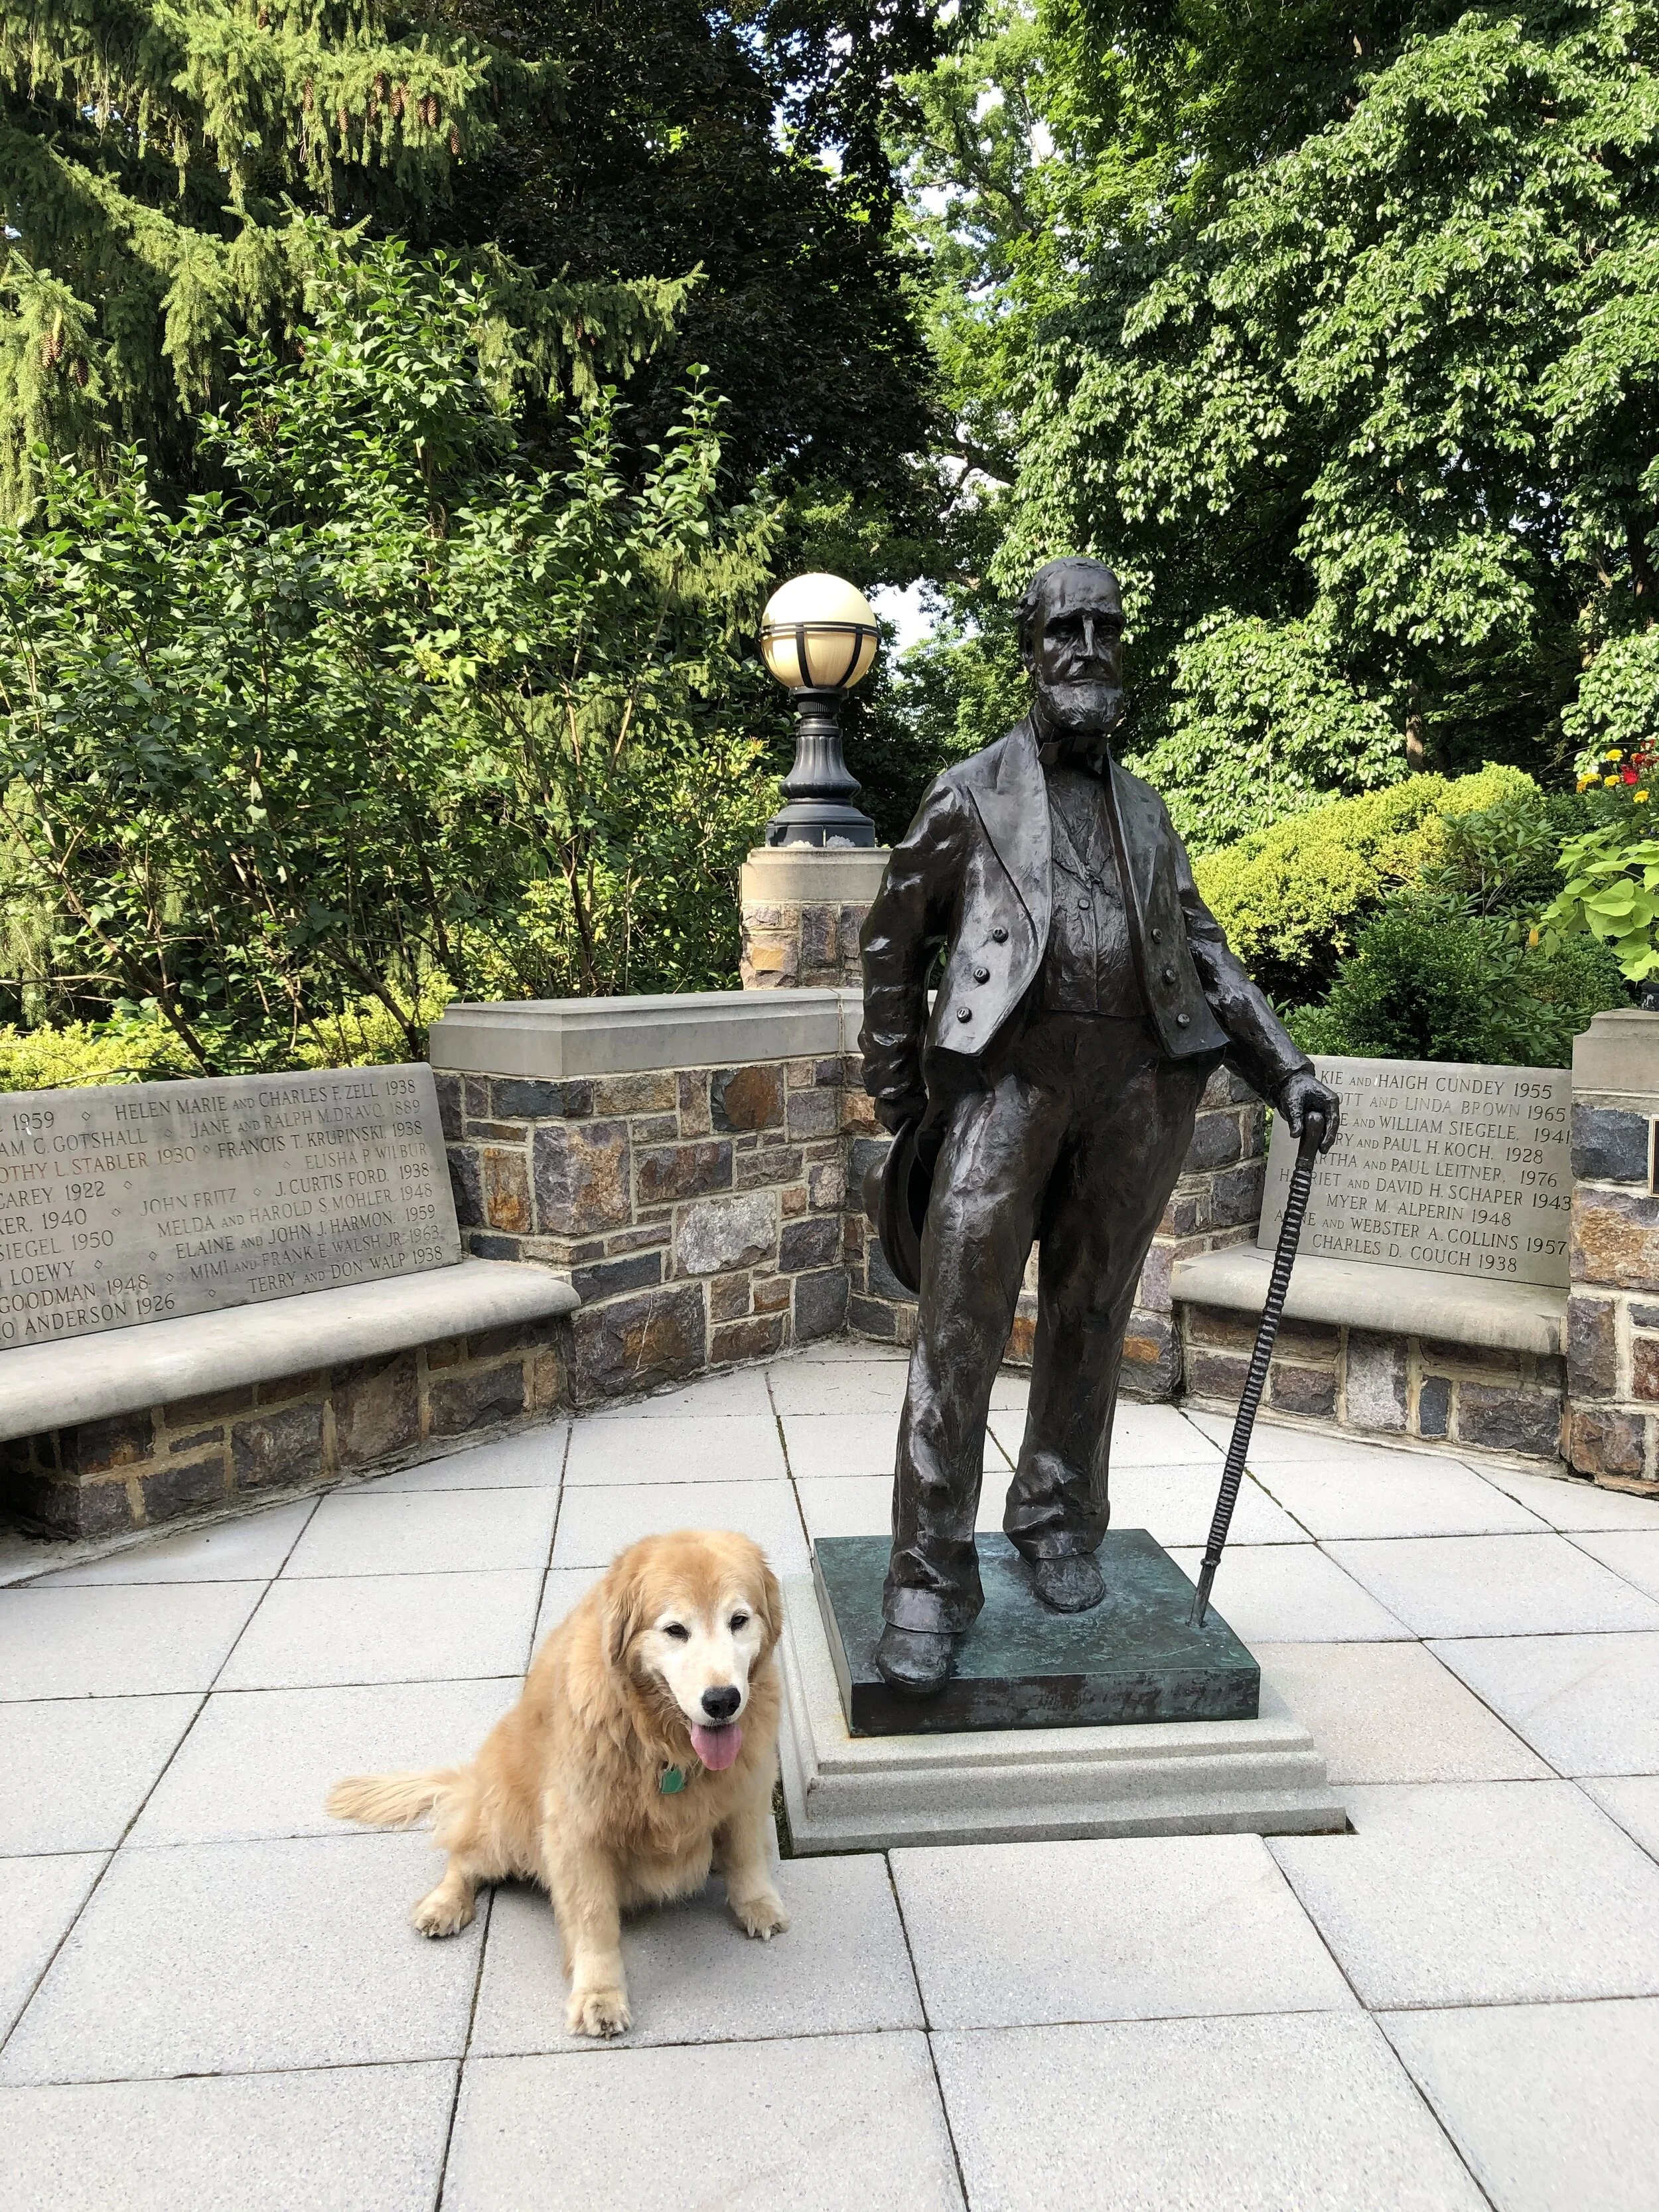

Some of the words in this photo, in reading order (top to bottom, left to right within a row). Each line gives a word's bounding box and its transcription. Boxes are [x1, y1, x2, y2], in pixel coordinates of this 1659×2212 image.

[13, 1112, 54, 1130] 1959
[115, 1101, 170, 1120] HELEN
[177, 1096, 228, 1114] MARIE
[233, 1098, 255, 1110] AND
[259, 1087, 327, 1107] CHARLES
[332, 1086, 342, 1100] F.
[345, 1084, 379, 1099] ZELL
[386, 1080, 415, 1095] 1938
[1349, 1076, 1372, 1086] AND
[1378, 1074, 1429, 1090] HAIGH
[1436, 1077, 1505, 1095] CUNDEY
[1514, 1082, 1552, 1100] 1955
[1370, 1096, 1398, 1109] AND
[1406, 1096, 1452, 1114] LINDA
[1461, 1100, 1520, 1118] BROWN
[1528, 1105, 1565, 1122] 1965
[34, 1138, 50, 1154] C.
[53, 1129, 147, 1152] GOTSHALL
[191, 1119, 232, 1138] JANE
[238, 1120, 260, 1132] AND
[264, 1110, 313, 1130] RALPH
[390, 1099, 420, 1115] 1889
[72, 1152, 149, 1175] STABLER
[157, 1146, 196, 1165] 1930
[218, 1136, 285, 1157] FRANCIS
[290, 1134, 303, 1149] T.
[392, 1120, 423, 1137] 1938
[1353, 1118, 1375, 1128] AND
[1379, 1116, 1443, 1134] WILLIAM
[1449, 1121, 1518, 1141] SIEGELE,
[1534, 1127, 1570, 1144] 1941
[1356, 1138, 1379, 1149] AND
[1384, 1136, 1421, 1153] PAUL
[1427, 1140, 1440, 1154] H.
[1506, 1147, 1543, 1164] 1928
[65, 1181, 106, 1201] 1922
[305, 1151, 358, 1169] ELISHA
[375, 1143, 427, 1159] WILBUR
[1279, 1168, 1342, 1187] HRIET
[1347, 1179, 1369, 1189] AND
[1376, 1177, 1423, 1195] DAVID
[1429, 1183, 1443, 1198] H.
[1448, 1185, 1523, 1205] SCHAPER
[1532, 1193, 1571, 1211] 1943
[1364, 1161, 1386, 1171] AND
[1391, 1158, 1429, 1175] PAUL
[1435, 1163, 1506, 1183] LEITNER,
[1520, 1169, 1558, 1187] 1976
[42, 1208, 86, 1229] 1940
[140, 1195, 188, 1217] JOHN
[193, 1188, 237, 1208] FRITZ
[275, 1181, 286, 1196] J.
[289, 1173, 343, 1194] CURTIS
[348, 1168, 390, 1187] FORD.
[399, 1163, 429, 1179] 1938
[72, 1230, 113, 1250] 1950
[157, 1216, 216, 1238] MELDA
[222, 1215, 244, 1227] AND
[249, 1200, 313, 1223] HAROLD
[400, 1183, 432, 1201] 1948
[1327, 1194, 1367, 1211] MYER
[1375, 1199, 1390, 1213] M.
[1397, 1202, 1463, 1220] ALPERIN
[1471, 1209, 1511, 1226] 1948
[10, 1260, 74, 1286] LOEWY
[175, 1236, 235, 1259] ELAINE
[241, 1236, 263, 1248] AND
[268, 1223, 312, 1244] JOHN
[317, 1221, 327, 1236] J.
[329, 1211, 396, 1234] HARMON.
[405, 1204, 435, 1222] 1959
[190, 1260, 229, 1281] MIMI
[234, 1260, 257, 1273] AND
[261, 1246, 314, 1266] FRANK
[332, 1234, 381, 1254] WALSH
[409, 1225, 439, 1243] 1963
[1273, 1210, 1316, 1226] ANE
[1322, 1219, 1344, 1230] AND
[1350, 1217, 1419, 1238] WEBSTER
[1427, 1227, 1443, 1241] A.
[1447, 1228, 1518, 1250] COLLINS
[1527, 1237, 1567, 1255] 1957
[1313, 1234, 1381, 1256] CHARLES
[1388, 1243, 1402, 1258] D.
[1411, 1246, 1471, 1266] COUCH
[1479, 1254, 1517, 1272] 1938
[25, 1301, 126, 1335] ANDERSON
[136, 1293, 175, 1315] 1926
[248, 1271, 296, 1293] TERRY
[304, 1271, 325, 1284] AND
[330, 1260, 363, 1279] DON
[369, 1252, 405, 1270] WALP
[413, 1246, 442, 1264] 1938
